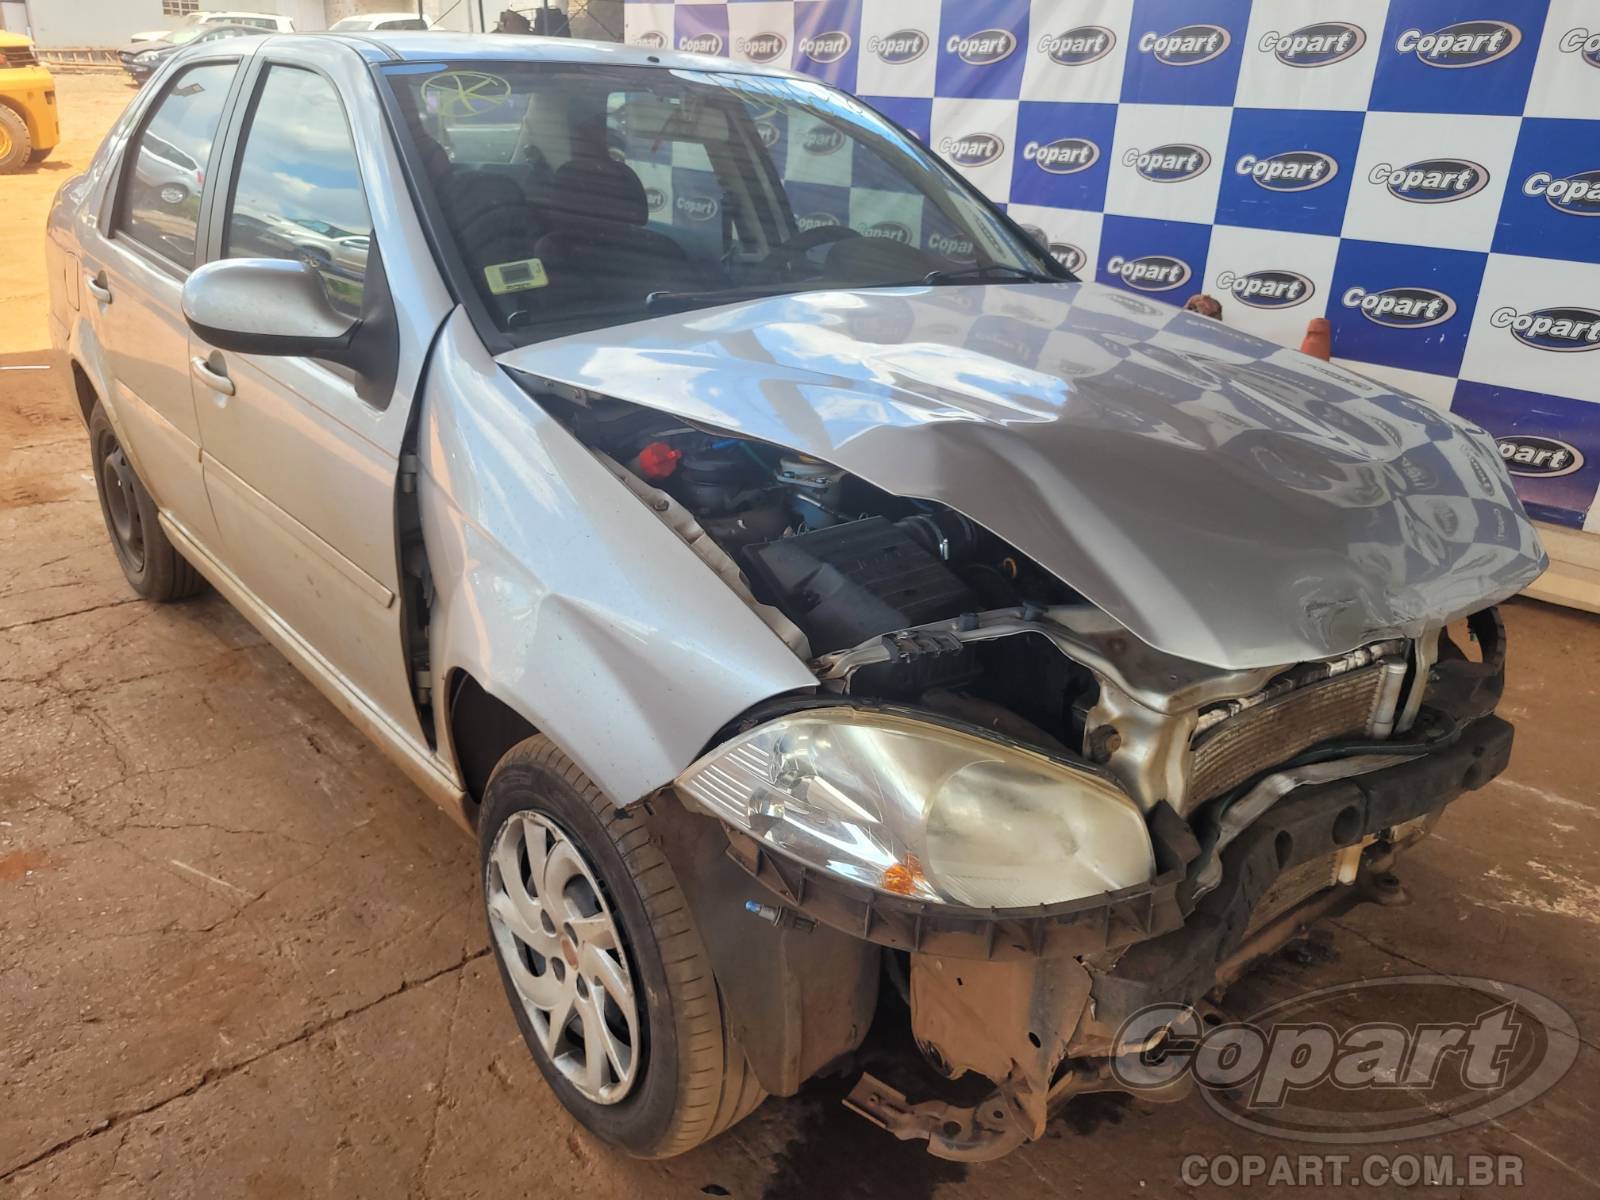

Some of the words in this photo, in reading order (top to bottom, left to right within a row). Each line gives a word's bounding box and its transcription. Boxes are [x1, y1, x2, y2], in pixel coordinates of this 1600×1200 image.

[679, 36, 717, 53] Copart
[736, 37, 779, 56] Copart
[799, 37, 845, 57] Copart
[867, 36, 920, 56] Copart
[946, 35, 1007, 57] Copart
[1038, 34, 1107, 57] Copart
[1139, 32, 1218, 59] Copart
[1259, 31, 1352, 57] Copart
[1396, 28, 1509, 55] Copart
[940, 138, 993, 158] Copart
[1023, 142, 1090, 166] Copart
[1122, 149, 1199, 177] Copart
[1235, 155, 1326, 183] Copart
[1368, 163, 1475, 192] Copart
[1107, 256, 1182, 282] Copart
[1216, 271, 1304, 300] Copart
[1342, 287, 1445, 320] Copart
